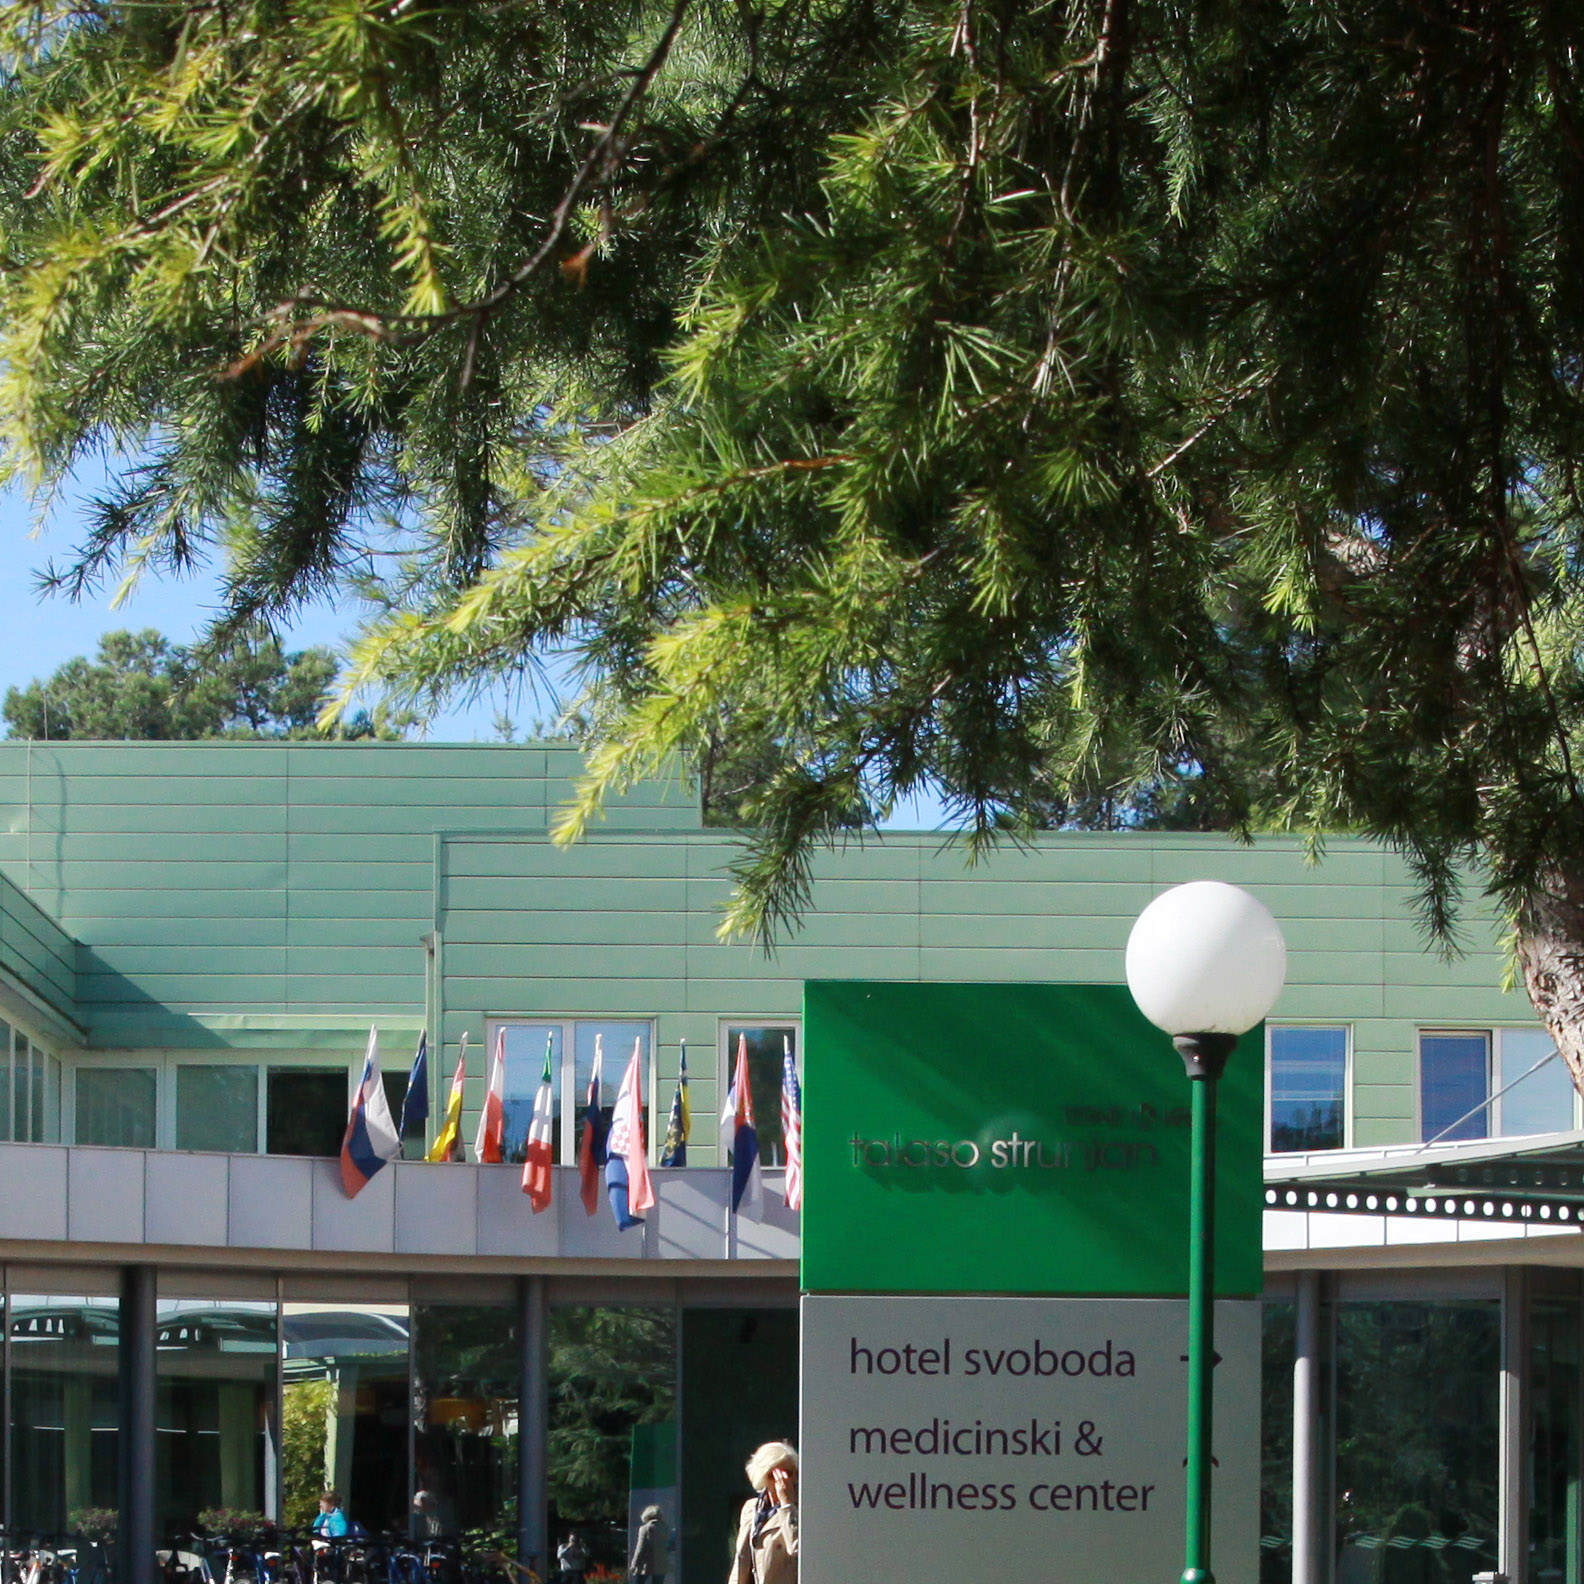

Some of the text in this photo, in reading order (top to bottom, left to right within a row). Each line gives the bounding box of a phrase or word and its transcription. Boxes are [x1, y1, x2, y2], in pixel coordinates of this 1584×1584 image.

[848, 1130, 1159, 1172] talaso strunjan
[849, 1337, 1136, 1377] hotel svoboda
[849, 1418, 1104, 1456] medicinski &
[848, 1473, 1156, 1512] wellness center
